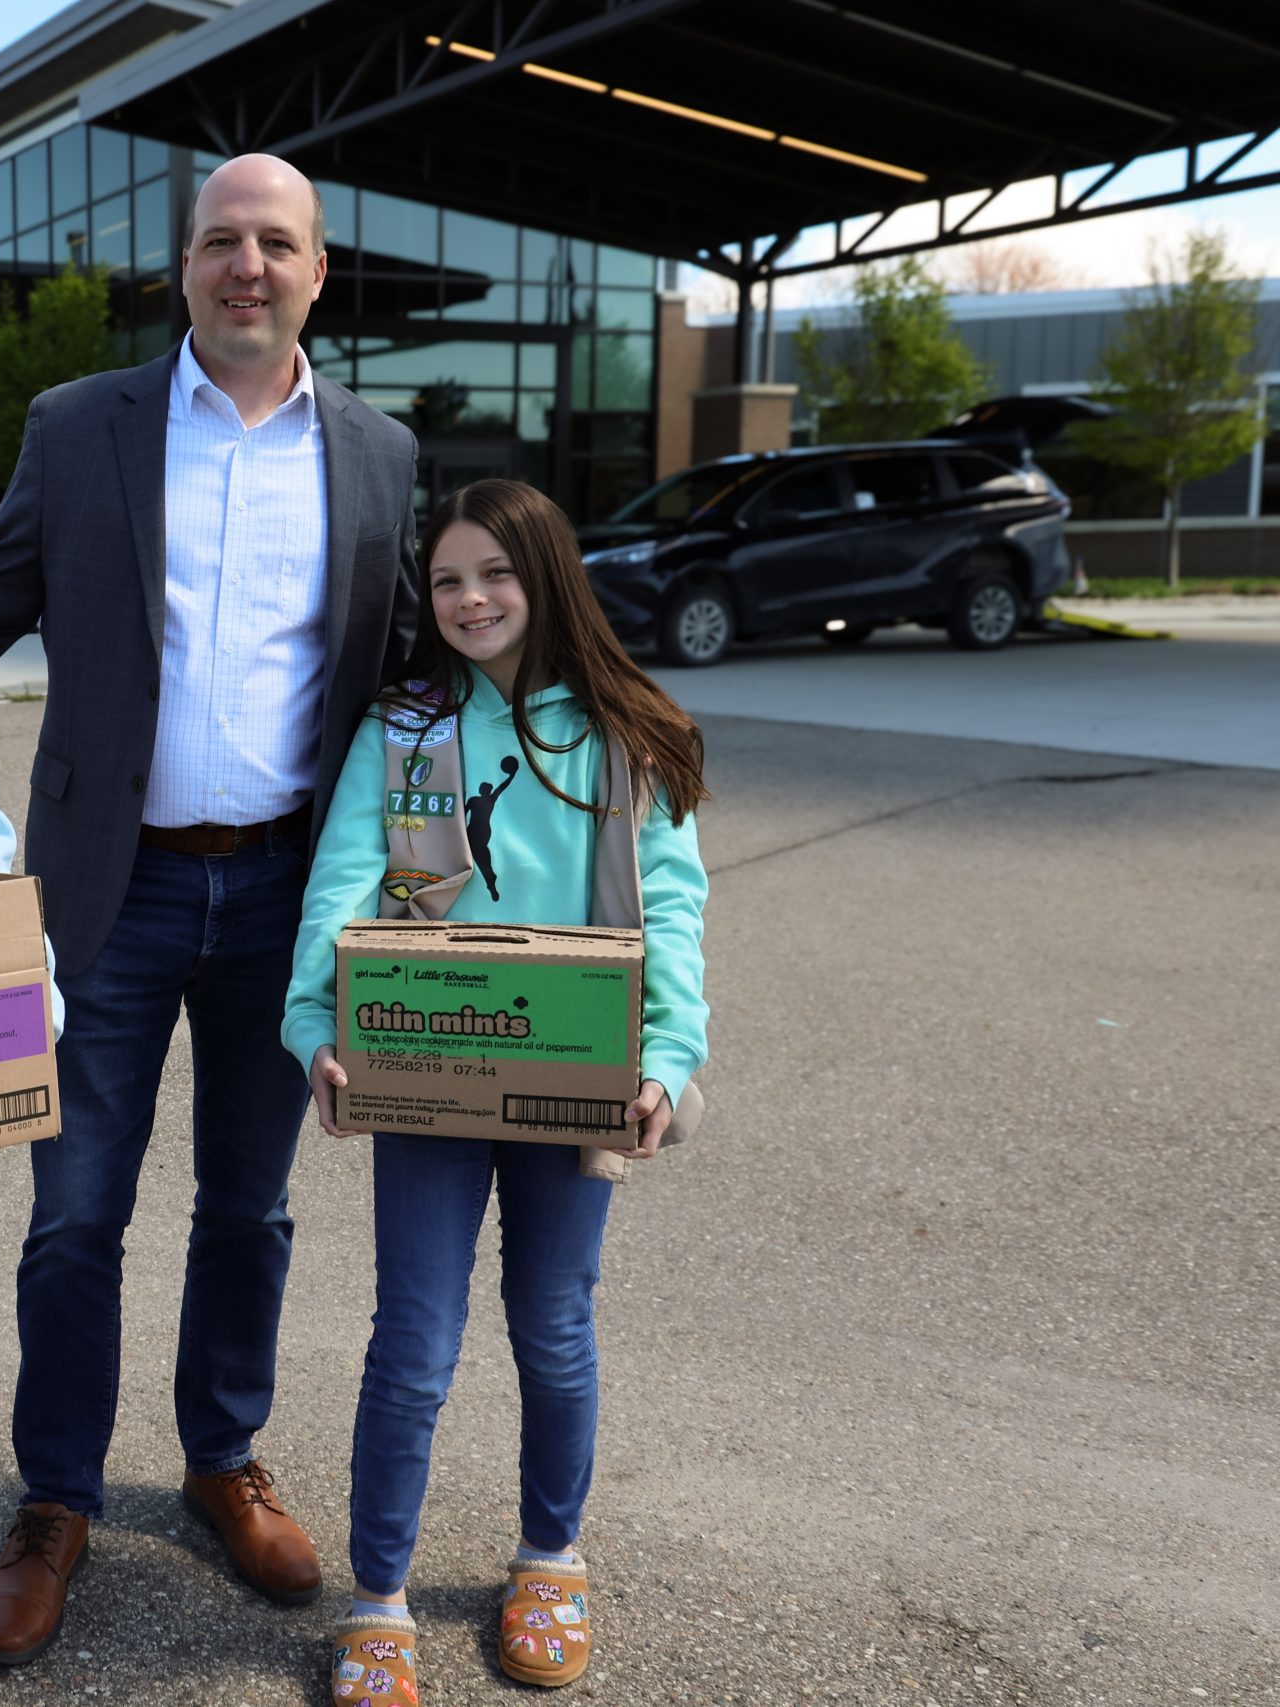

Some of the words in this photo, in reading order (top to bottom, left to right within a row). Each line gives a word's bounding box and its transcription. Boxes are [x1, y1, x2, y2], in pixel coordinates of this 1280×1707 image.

[355, 970, 369, 979] girl
[370, 971, 394, 979] scouts
[414, 970, 441, 981] Little
[442, 971, 488, 983] Brownie
[356, 1001, 425, 1033] thin
[429, 1005, 531, 1038] mints
[476, 1040, 492, 1048] with
[495, 1040, 522, 1049] natural
[536, 1042, 544, 1050] of
[546, 1044, 592, 1053] peppermint
[367, 1059, 442, 1073] 77258219
[454, 1064, 496, 1077] 07:44
[350, 1112, 371, 1121] NOT
[374, 1113, 394, 1123] FOR
[397, 1115, 435, 1125] RESALE
